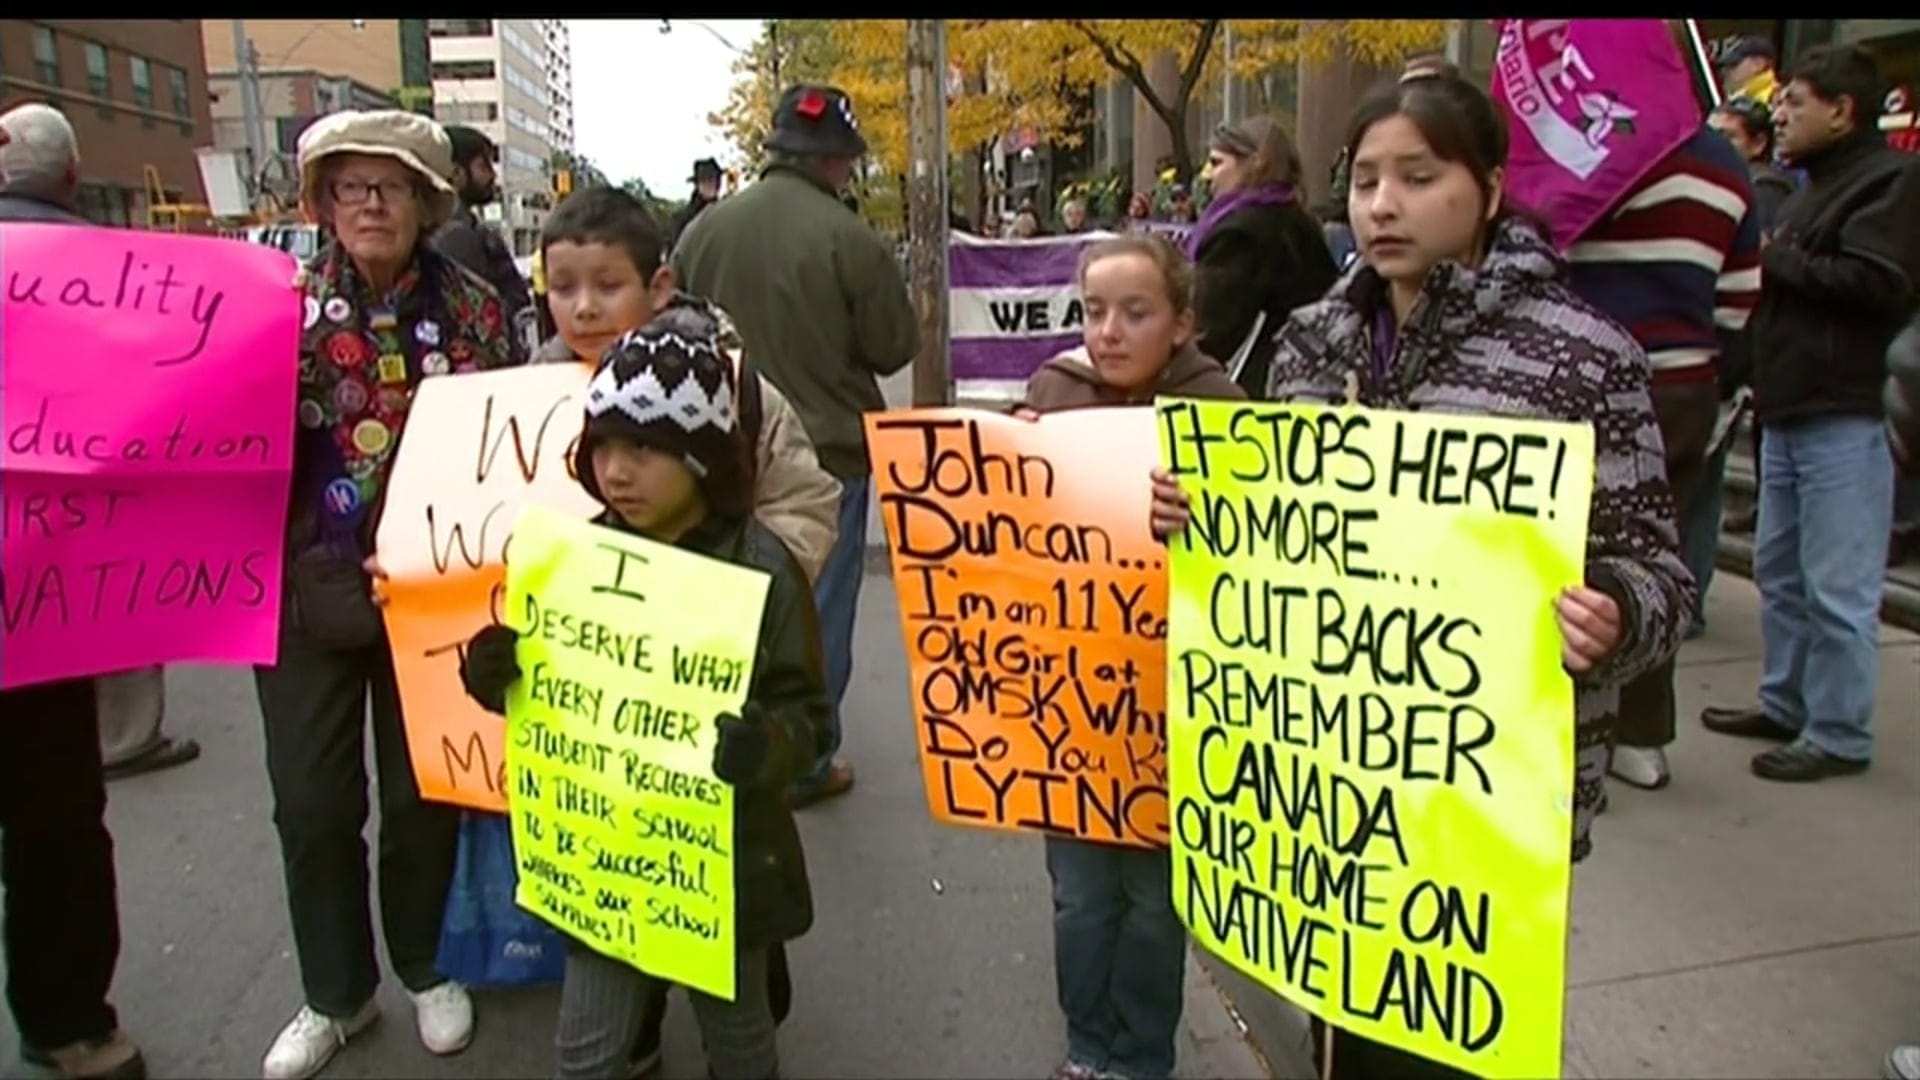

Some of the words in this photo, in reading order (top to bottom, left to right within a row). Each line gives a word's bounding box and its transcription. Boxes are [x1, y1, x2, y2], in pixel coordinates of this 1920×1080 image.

[990, 301, 1050, 332] WE
[876, 419, 1055, 498] John
[1229, 409, 1376, 492] STOPS
[1390, 421, 1567, 520] HERE!
[880, 492, 1162, 569] Duncan...
[1183, 488, 1241, 558] NO
[591, 542, 649, 602] I
[901, 566, 996, 623] I'm
[1005, 601, 1047, 628] an
[1052, 578, 1100, 633] 11
[516, 593, 653, 673] DESERVE
[673, 644, 748, 694] WHAT
[917, 624, 986, 668] Old
[994, 634, 1077, 680] Girl
[1094, 659, 1141, 684] at
[1211, 572, 1309, 660] CUT
[1311, 587, 1482, 699] BACKS
[531, 661, 603, 725] EVERY
[613, 697, 700, 748] OTHER
[923, 666, 1070, 727] OMSK
[1179, 649, 1496, 796] REMEMBER
[922, 714, 1009, 761] Do
[1030, 720, 1107, 775] You
[518, 765, 541, 799] IN
[552, 775, 618, 830] THEIR
[942, 759, 1170, 850] LYING
[1198, 725, 1409, 868] CANADA
[553, 821, 577, 856] BE
[1176, 796, 1257, 883] OUR
[1270, 831, 1392, 930] HOME
[1400, 878, 1490, 956] ON
[1186, 855, 1337, 1000] NATIVE
[1341, 929, 1505, 1053] LAND
